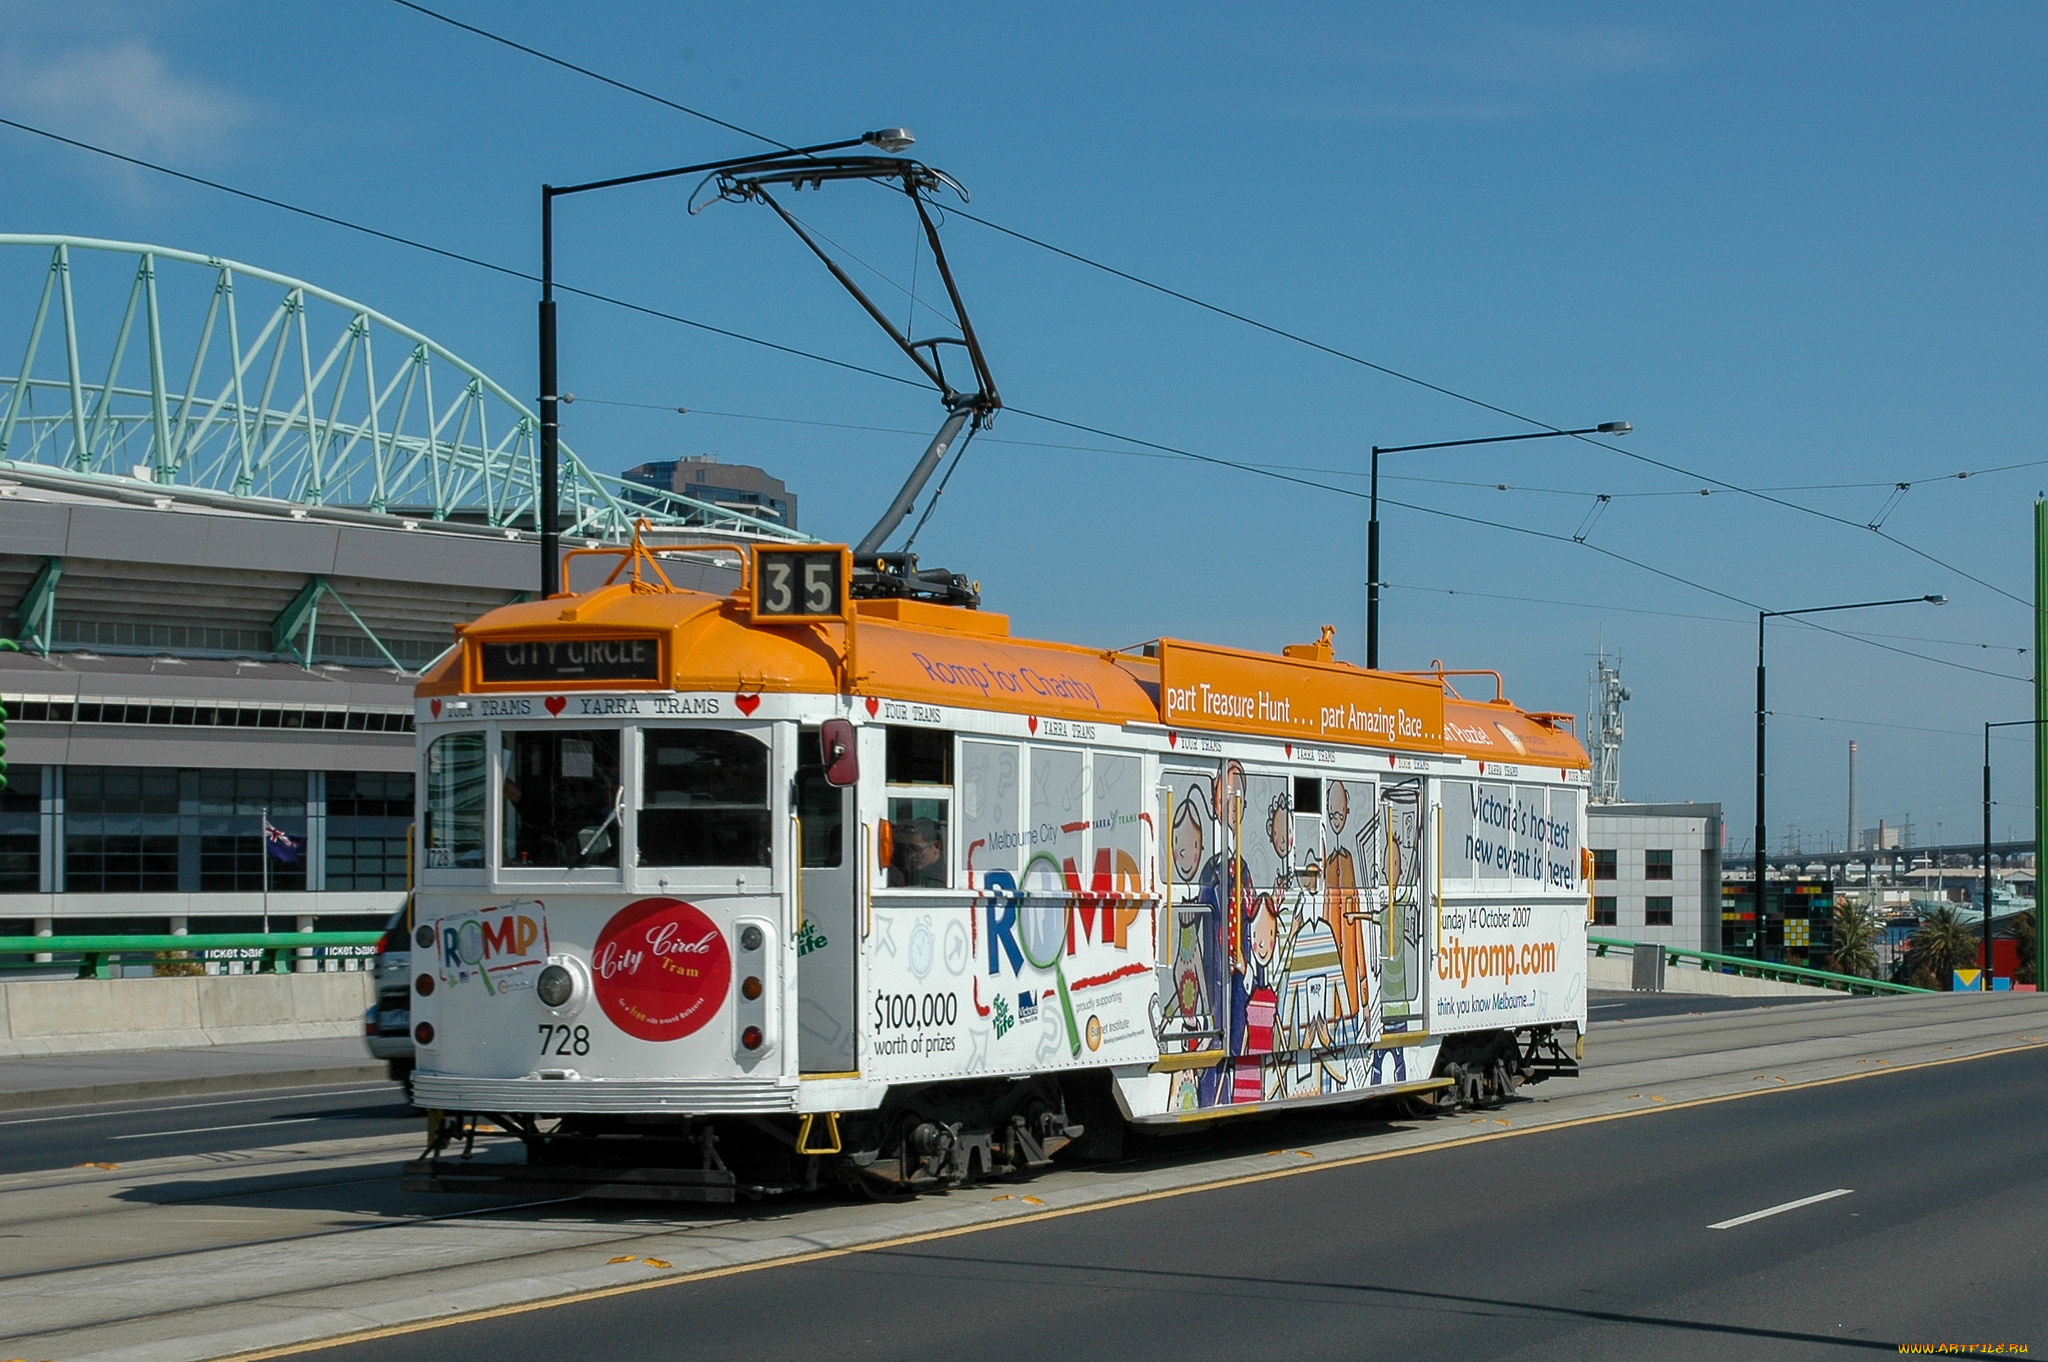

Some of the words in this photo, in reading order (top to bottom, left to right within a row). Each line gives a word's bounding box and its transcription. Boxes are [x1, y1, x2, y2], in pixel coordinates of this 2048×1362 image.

[765, 562, 832, 613] 35
[505, 642, 557, 665] CITY
[567, 641, 646, 664] CIRCLE
[911, 652, 989, 698] Romp
[983, 662, 1024, 693] for
[1020, 667, 1100, 710] Charity
[480, 699, 532, 716] TRAMS
[580, 698, 641, 715] YARRA
[653, 697, 720, 715] TRAMS
[884, 704, 908, 720] YOUR
[912, 705, 942, 724] TRAMS
[1167, 685, 1196, 718] part
[1199, 683, 1255, 719] Treasure
[1320, 706, 1345, 735] part
[1348, 703, 1396, 743] Amazing
[1043, 720, 1068, 737] YARRA
[1071, 723, 1096, 740] TRAMS
[1469, 783, 1527, 836] Victoria's
[1530, 805, 1570, 850] hottest
[988, 831, 1039, 851] Melbourne
[1040, 822, 1059, 845] City
[1465, 834, 1493, 866] new
[1496, 843, 1530, 878] event
[1533, 847, 1542, 882] is
[1547, 850, 1575, 891] here!
[983, 847, 1143, 978] ROMP
[1440, 908, 1467, 934] unday
[1468, 908, 1477, 929] 14
[1478, 907, 1511, 929] October
[1512, 907, 1532, 929] 2007
[204, 948, 238, 959] Ticket
[325, 946, 353, 956] Ticket
[443, 915, 539, 968] ROMP
[592, 941, 645, 979] City
[645, 922, 718, 956] Circle
[661, 956, 699, 978] Tram
[1437, 935, 1556, 989] cityromp.com
[874, 989, 958, 1035] $100,000
[1437, 996, 1454, 1016] think
[1456, 998, 1470, 1019] you
[1471, 994, 1491, 1012] know
[538, 1024, 591, 1056] 728
[874, 1033, 906, 1056] worth
[908, 1032, 924, 1054] of
[925, 1033, 956, 1058] prizes
